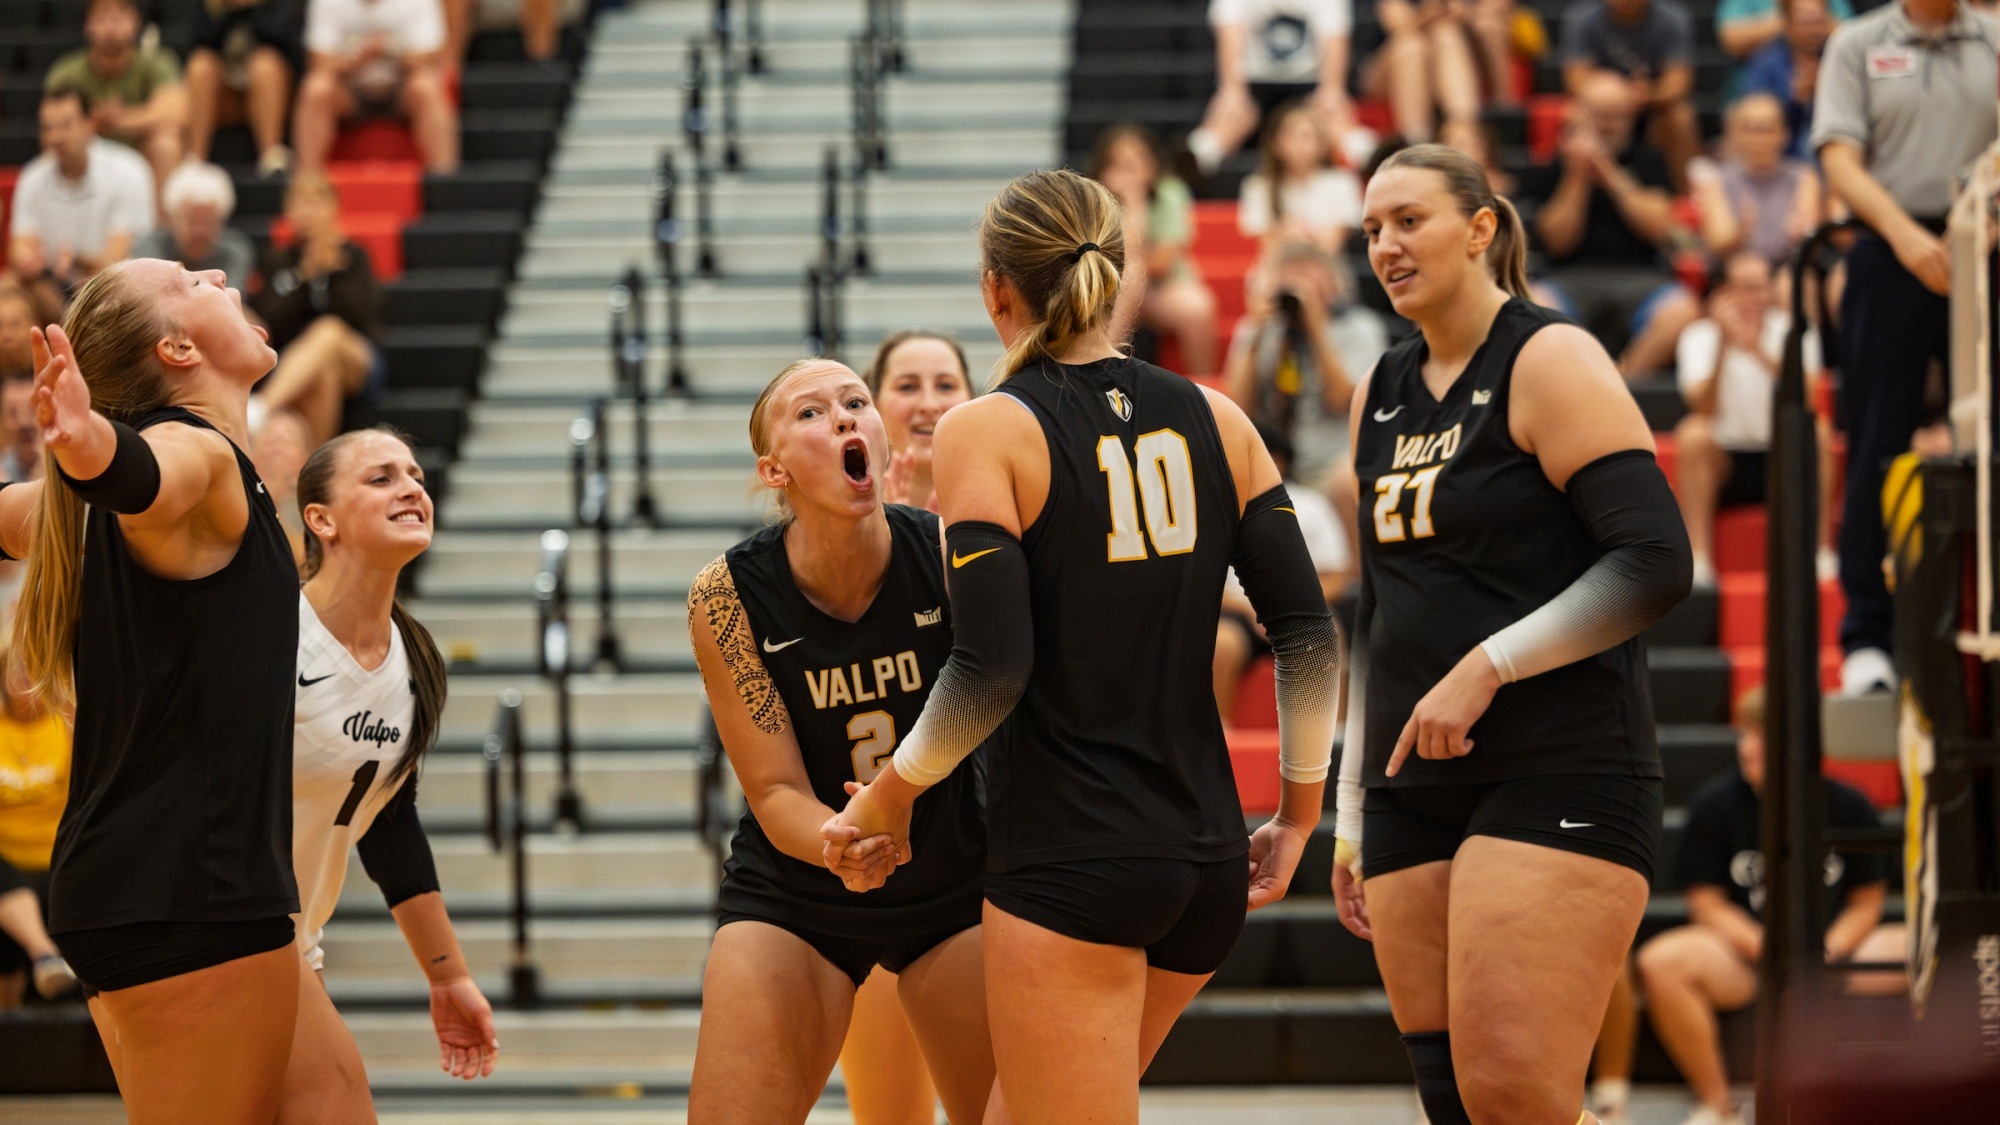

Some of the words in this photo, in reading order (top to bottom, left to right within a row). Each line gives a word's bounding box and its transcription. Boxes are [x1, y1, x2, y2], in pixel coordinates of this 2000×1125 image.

[1391, 422, 1463, 470] VALPO
[1096, 427, 1197, 562] 10
[804, 650, 923, 709] VALPO
[342, 710, 401, 749] Valpo
[846, 709, 897, 785] 2
[333, 760, 380, 826] 1
